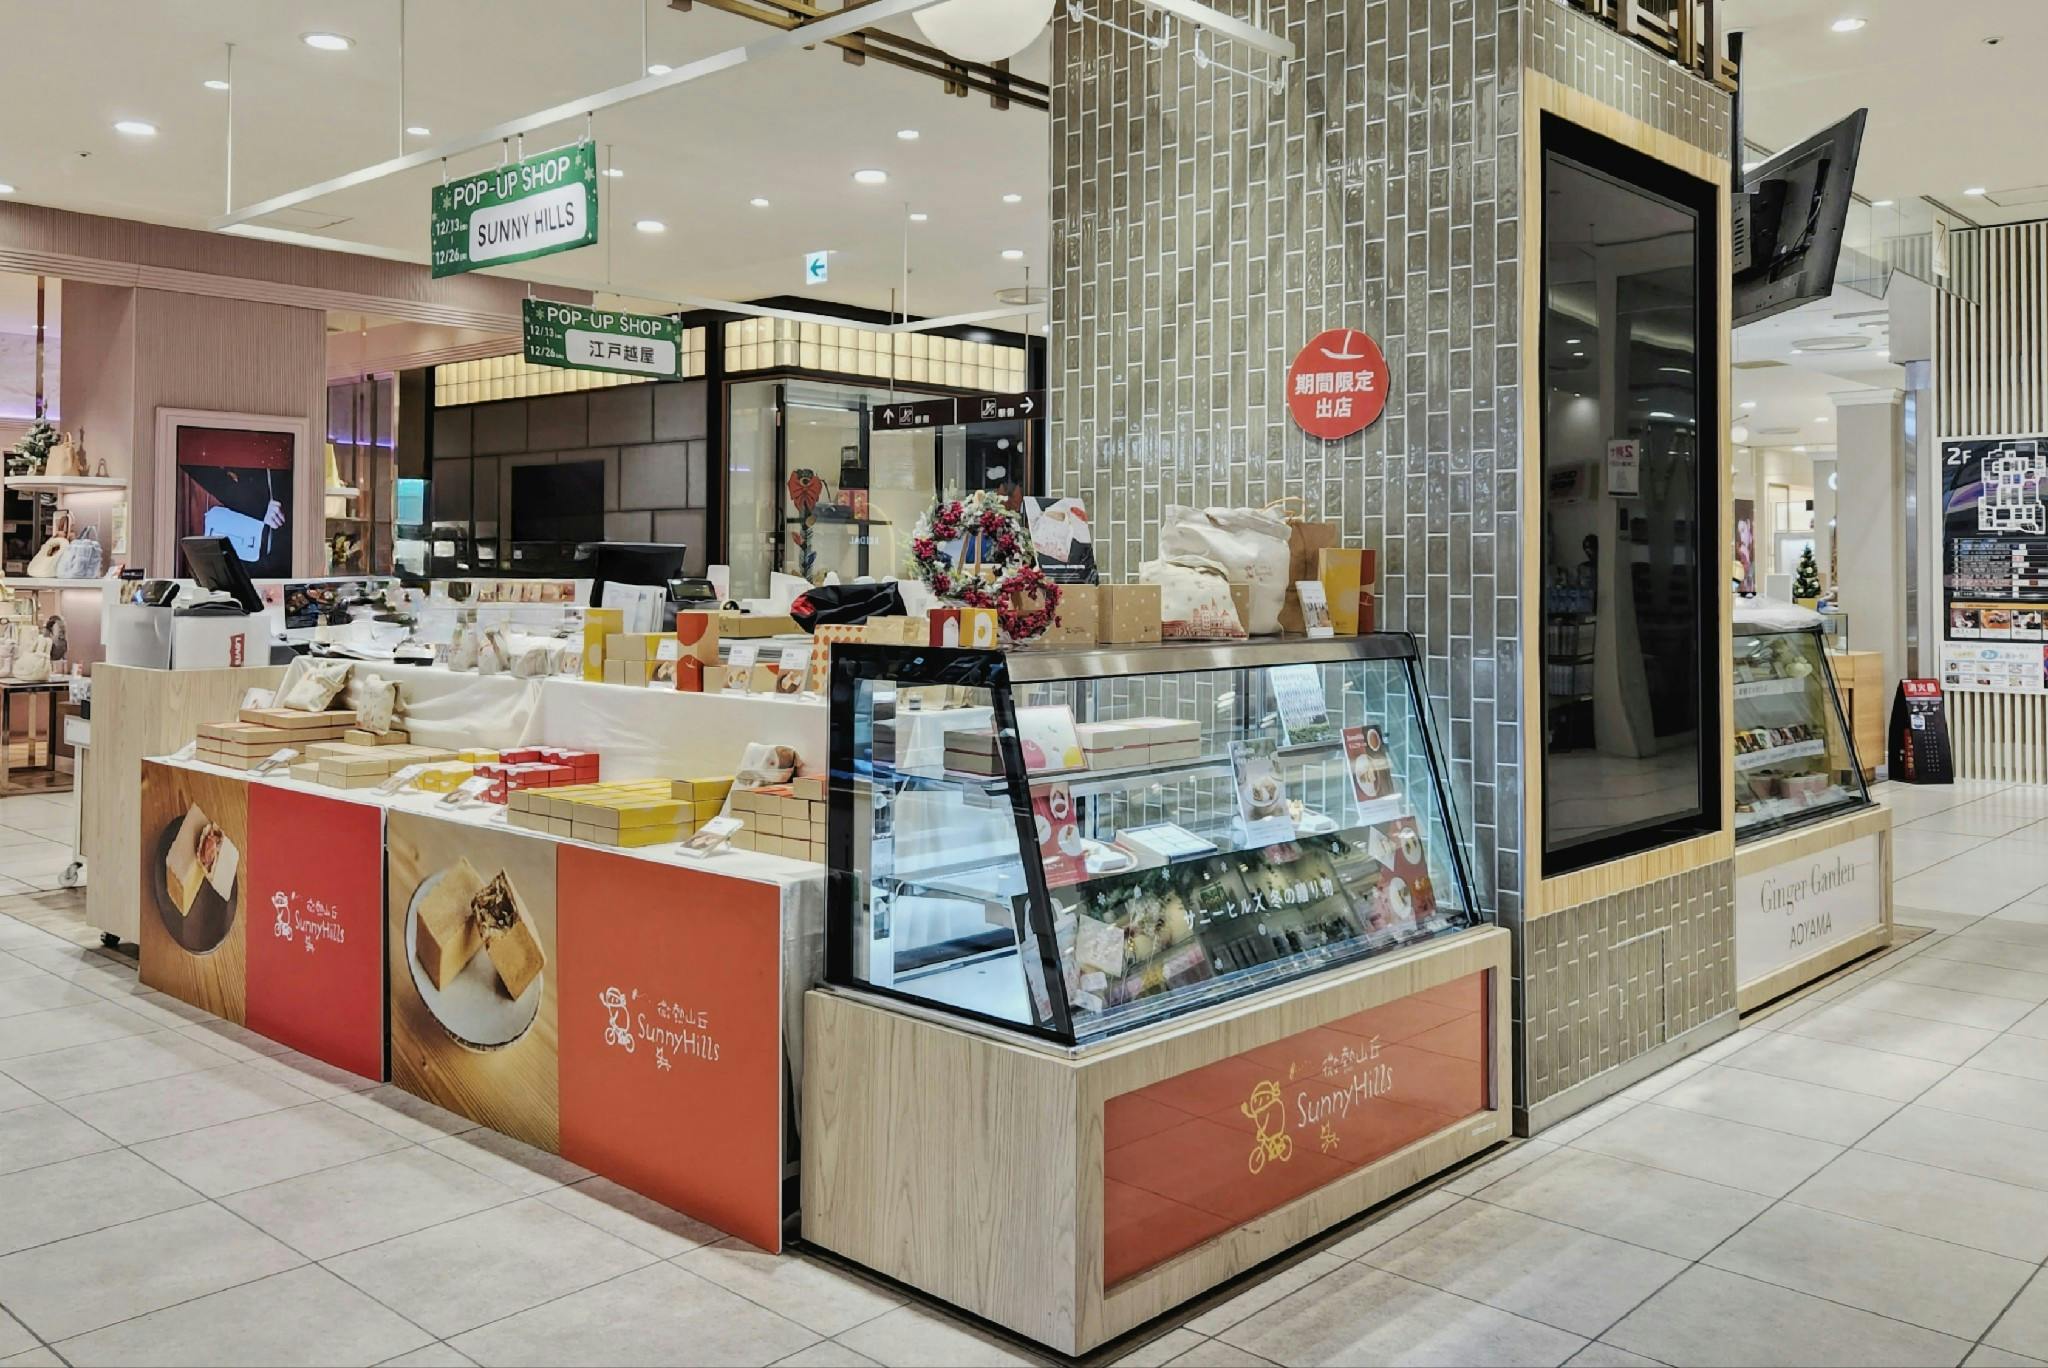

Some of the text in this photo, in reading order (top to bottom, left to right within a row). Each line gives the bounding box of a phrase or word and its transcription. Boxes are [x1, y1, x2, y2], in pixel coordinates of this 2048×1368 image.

[453, 156, 571, 211] POP-UP SHOP
[477, 202, 575, 247] SUNNY HILLS
[547, 306, 662, 336] POP-UP SHOP
[589, 339, 655, 364] 江戸越屋
[1294, 369, 1375, 396] 期間限定
[1315, 396, 1354, 419] 出店
[1946, 447, 1972, 466] 2F
[1760, 856, 1856, 915] Ginger Garden
[294, 909, 345, 944] SunnyHills
[1789, 911, 1832, 949] AOYAMA
[637, 1012, 720, 1061] SunnyHills
[1296, 1062, 1394, 1129] SunnyHills
